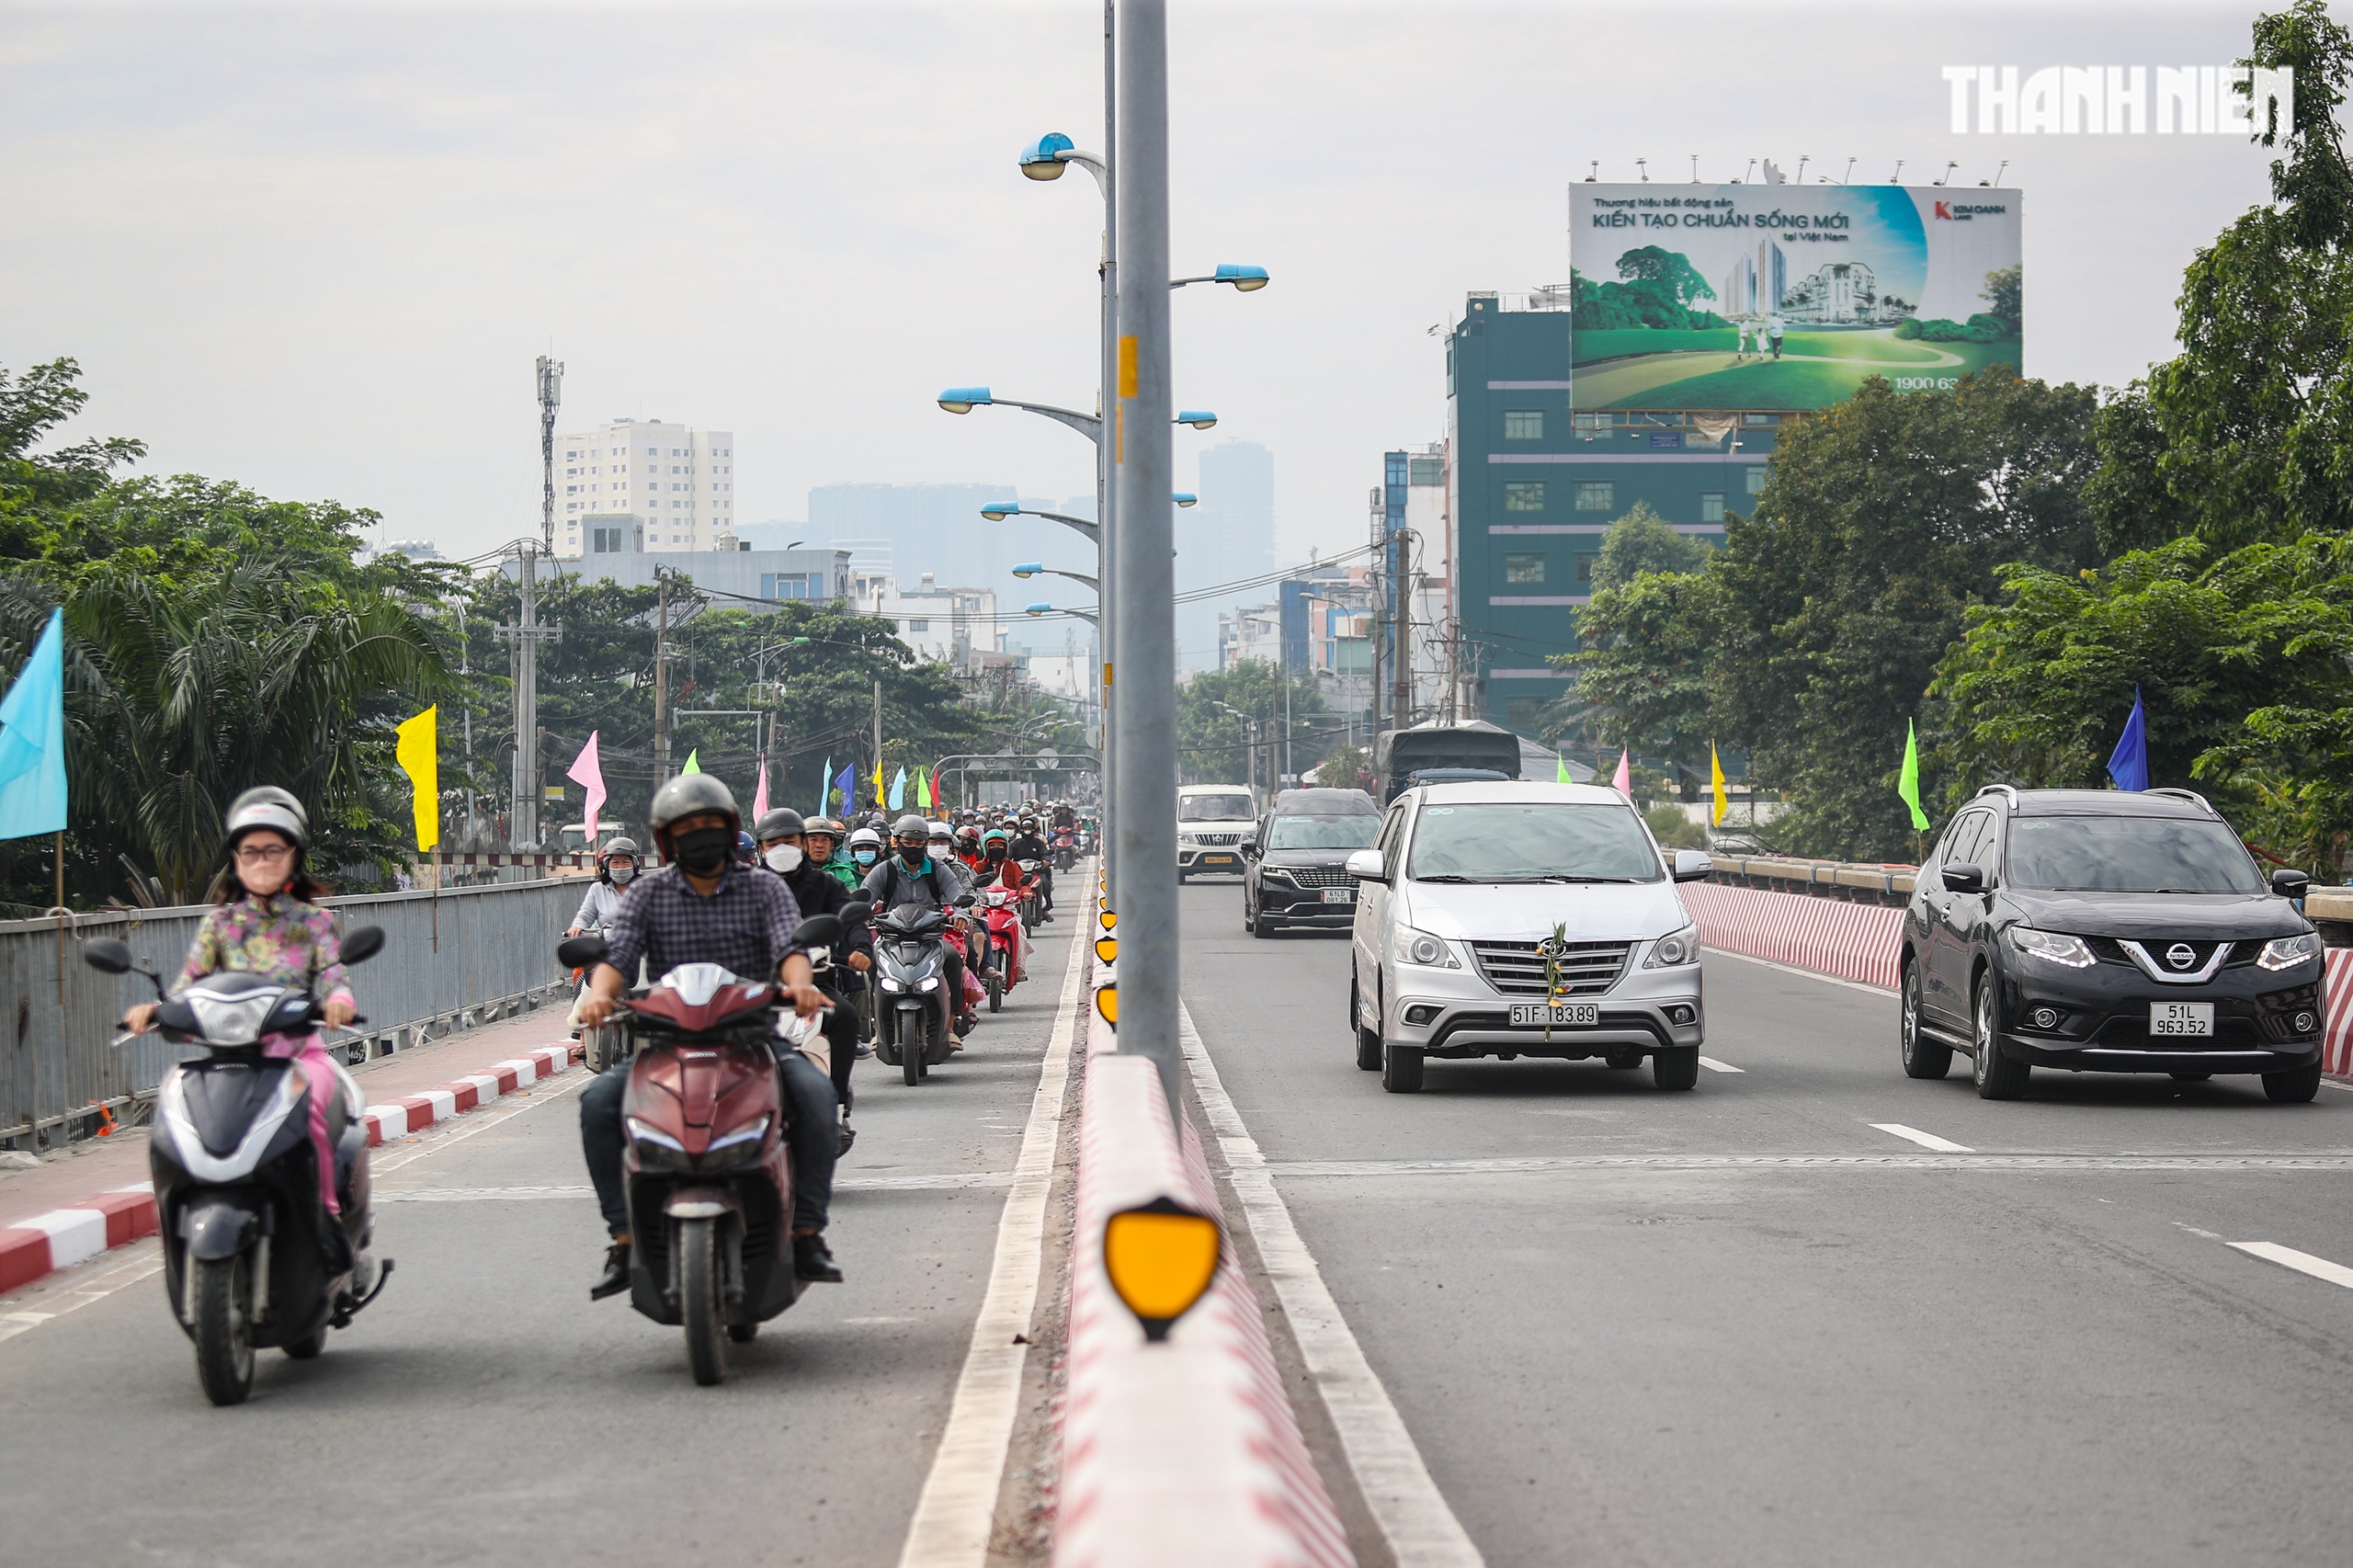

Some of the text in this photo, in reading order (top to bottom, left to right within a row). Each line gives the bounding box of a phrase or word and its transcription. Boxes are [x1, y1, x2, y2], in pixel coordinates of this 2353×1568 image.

[1594, 197, 1733, 209] Thương hiệu bất động sản
[1974, 205, 2006, 214] OANH
[1593, 208, 1849, 229] KIẾN TẠO CHUẨN SỐNG MỚI
[1800, 233, 1822, 242] Việt
[1824, 233, 1849, 242] Nam
[1895, 377, 1935, 390] 1900
[2169, 1006, 2195, 1018] 51L
[2157, 1020, 2206, 1034] 963.52
